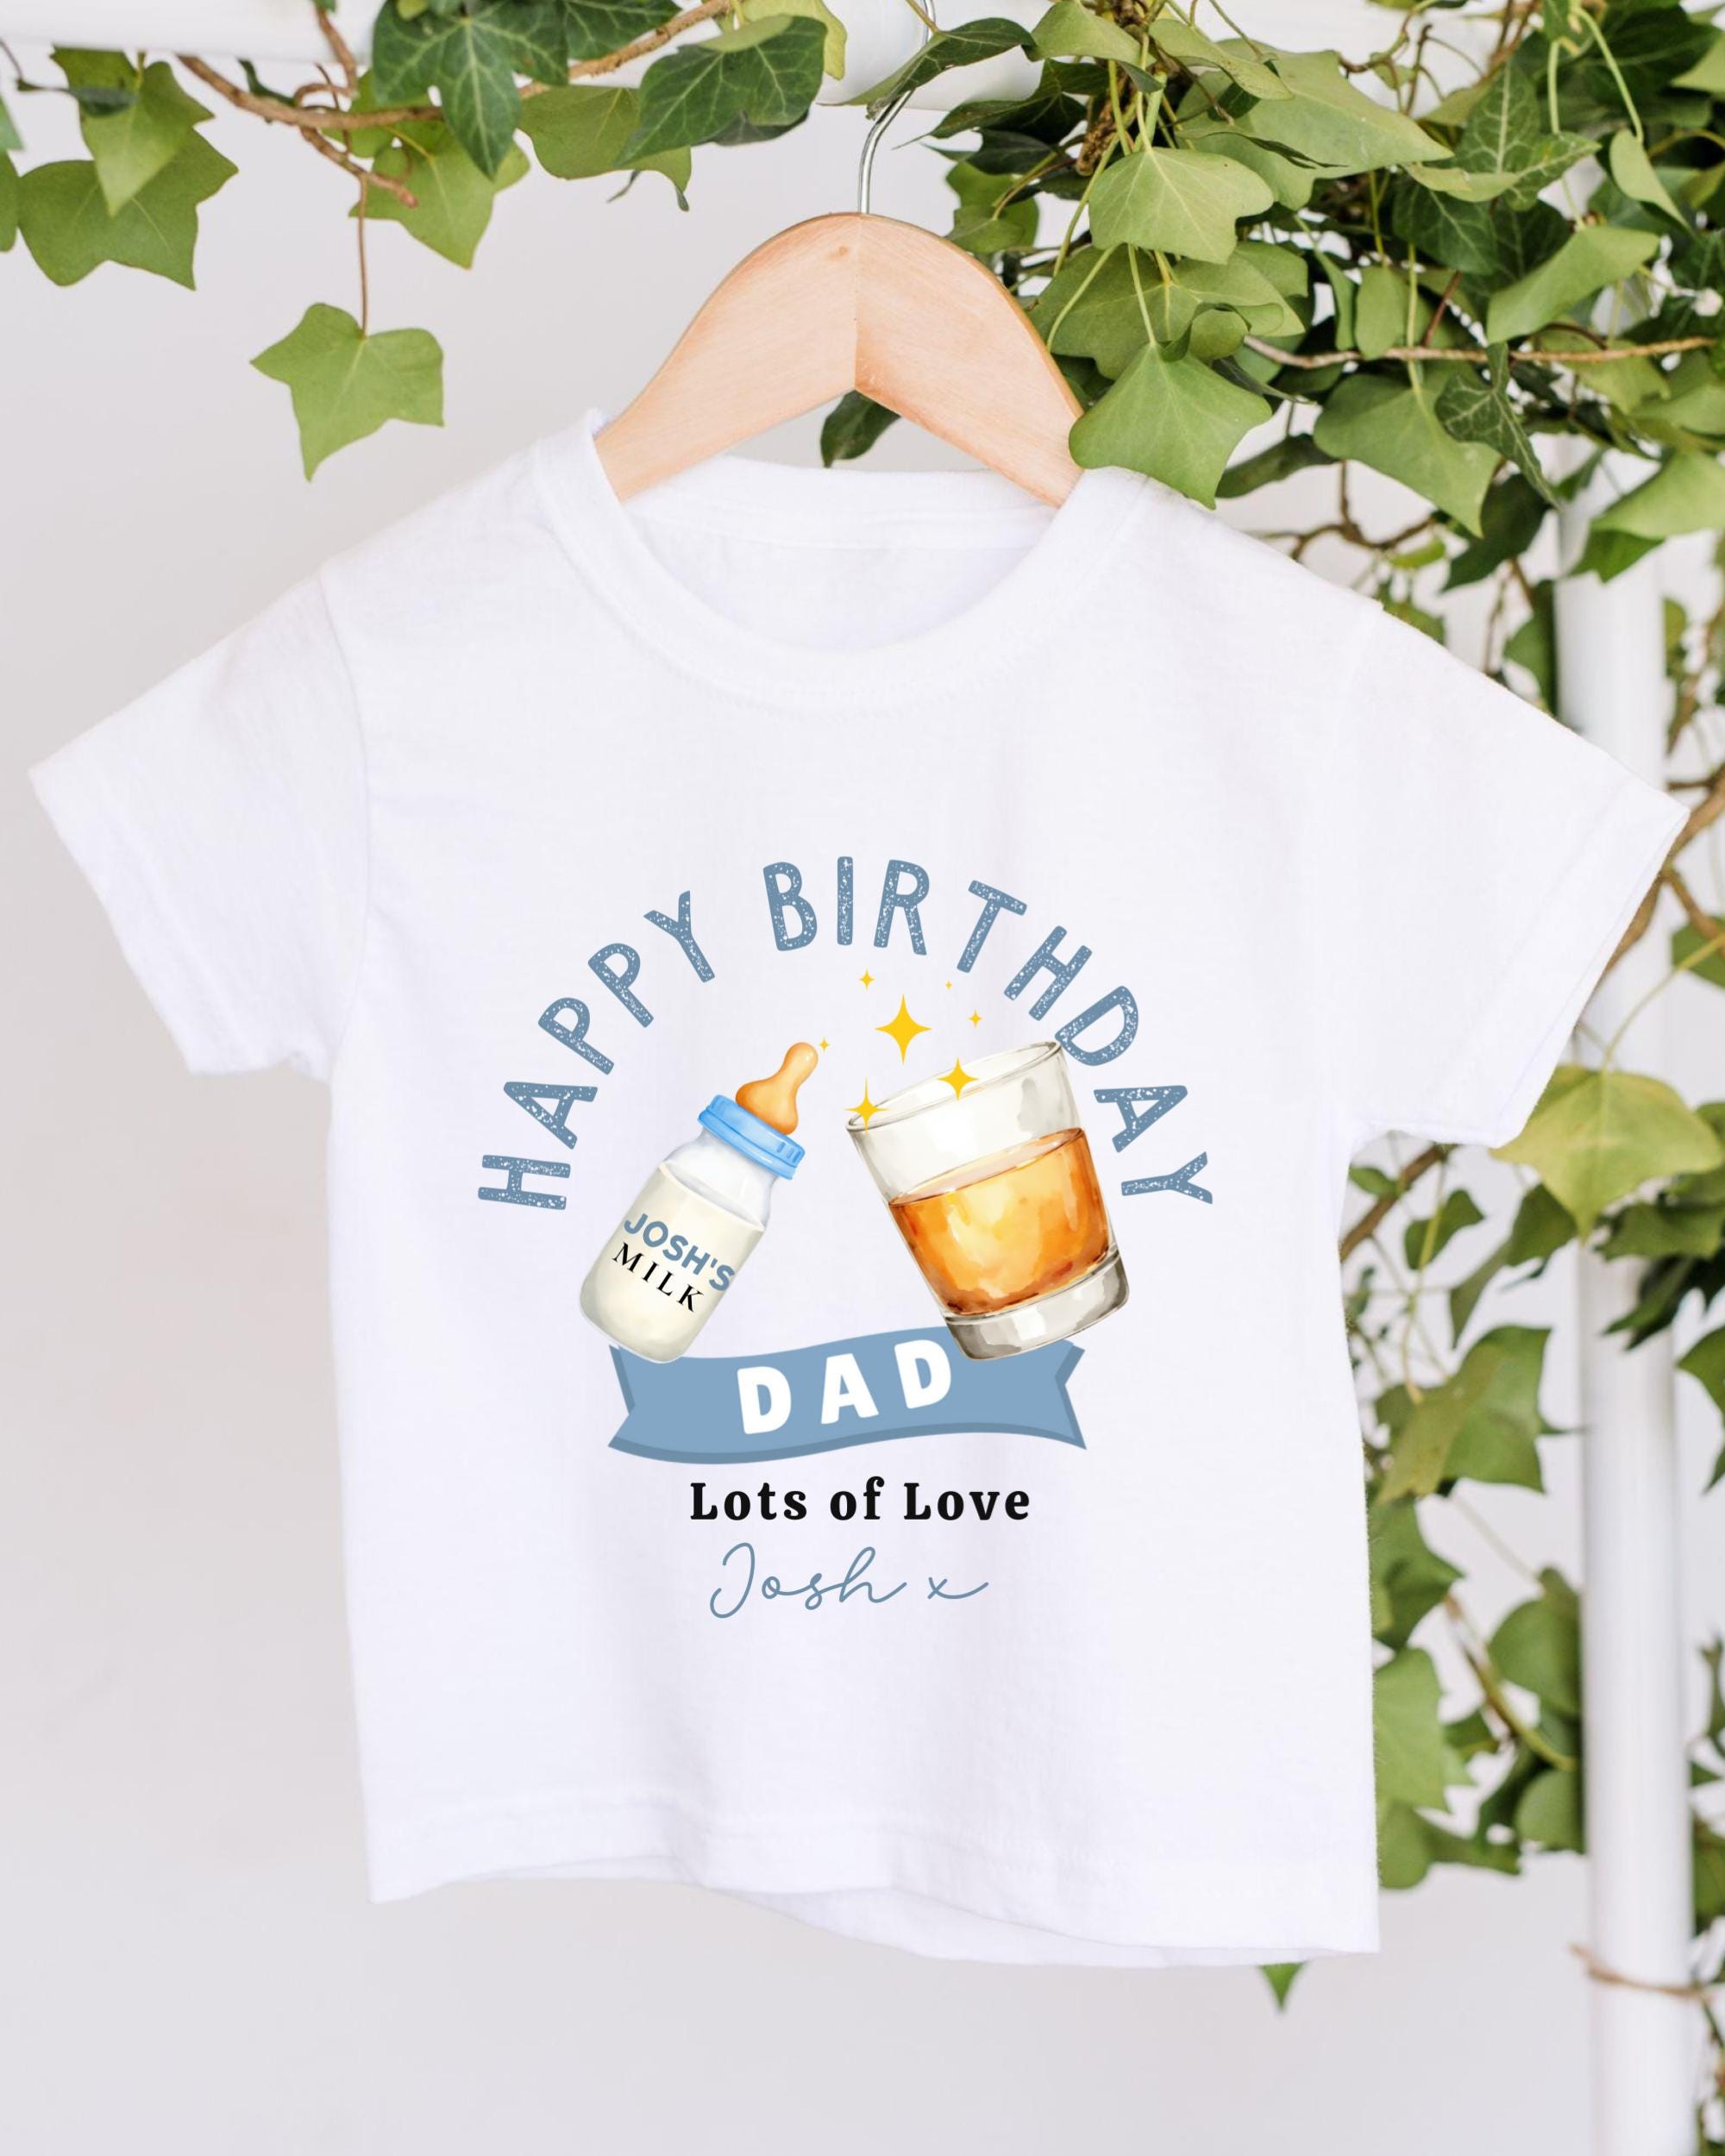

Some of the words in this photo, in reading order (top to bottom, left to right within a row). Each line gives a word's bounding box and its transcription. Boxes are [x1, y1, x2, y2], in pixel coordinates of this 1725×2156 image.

[477, 890, 716, 1211] HAPPY
[762, 856, 1214, 1205] BIRTHDAY
[612, 1242, 705, 1313] MILK
[624, 1213, 736, 1292] JOSH'S
[737, 1338, 952, 1435] DAD
[690, 1482, 808, 1522] Lots
[829, 1476, 885, 1522] of
[903, 1482, 1031, 1522] Love
[710, 1541, 908, 1619] Josh
[927, 1574, 989, 1601] x
